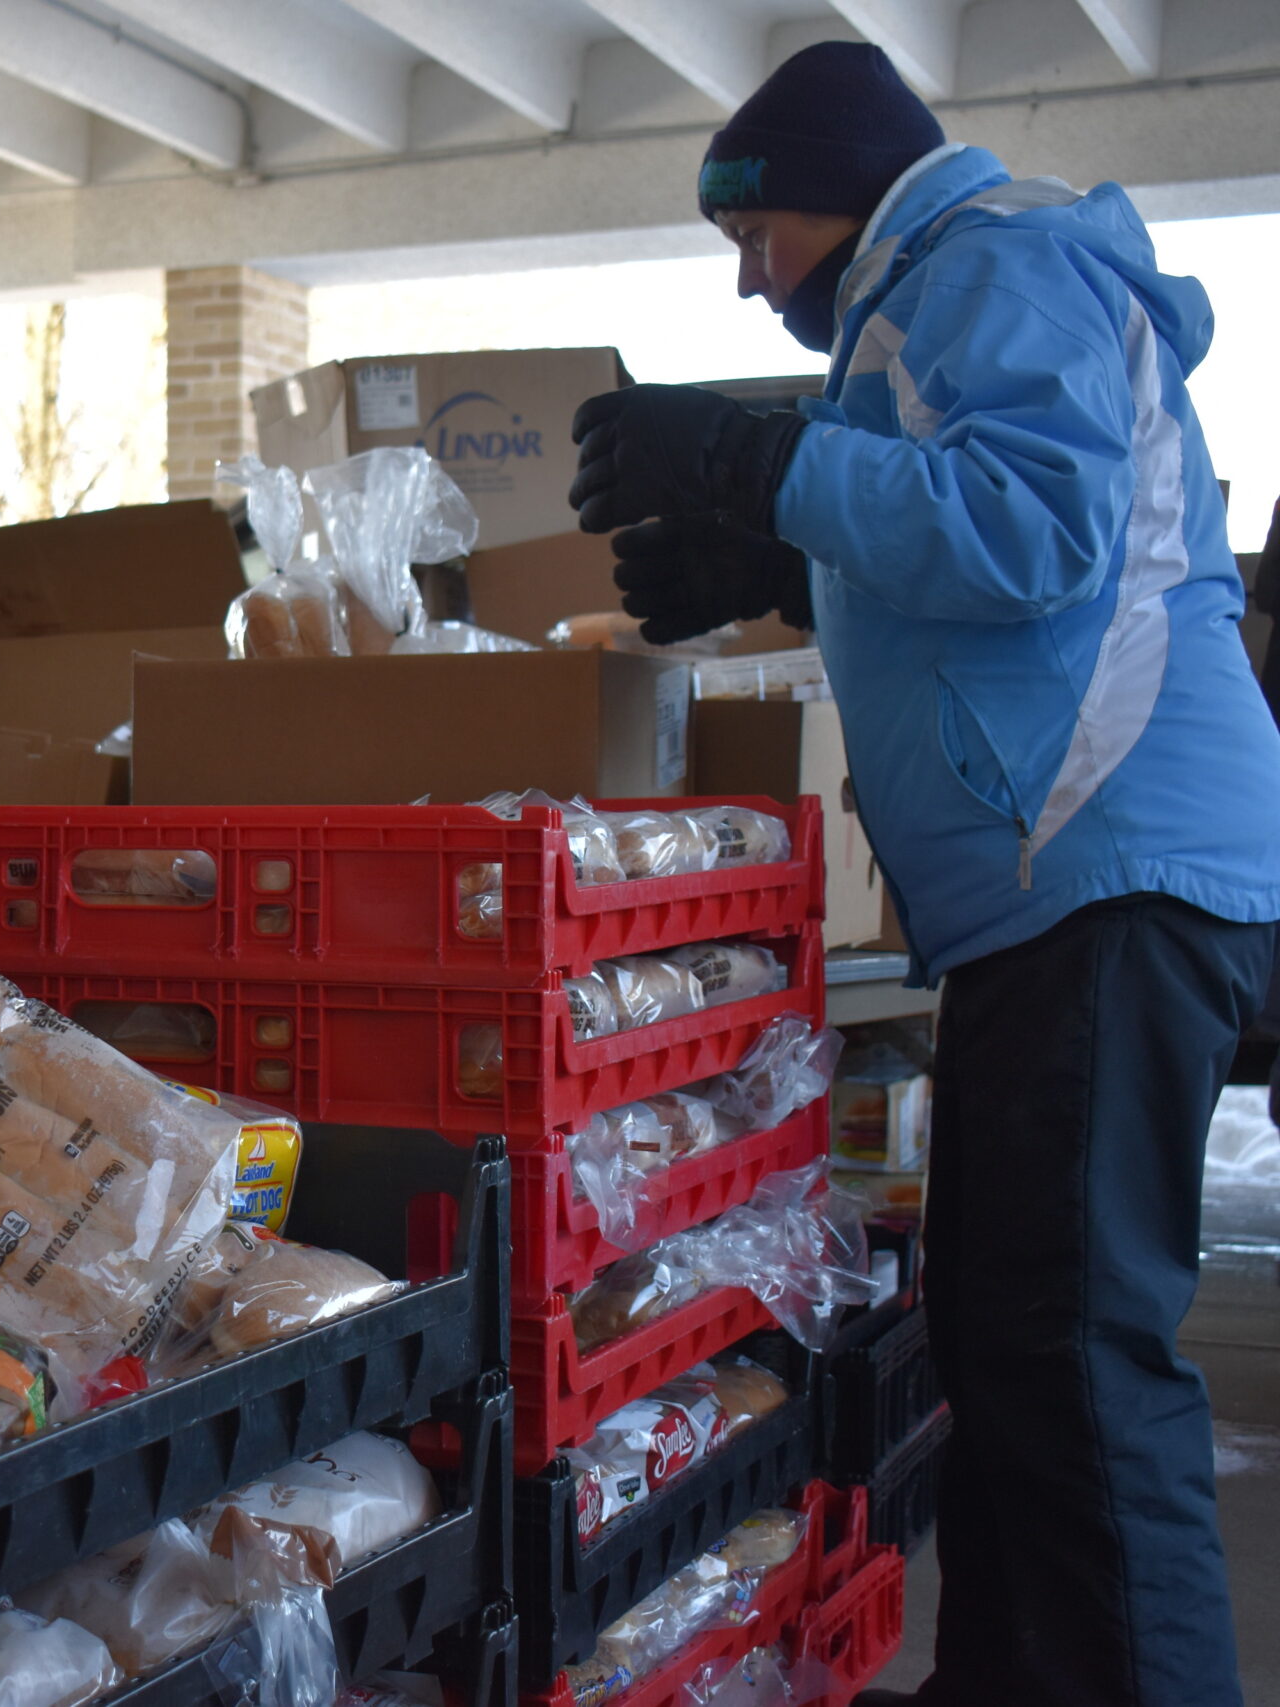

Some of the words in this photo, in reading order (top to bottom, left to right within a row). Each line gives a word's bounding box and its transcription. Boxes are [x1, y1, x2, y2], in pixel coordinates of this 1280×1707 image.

[436, 426, 544, 463] LINDAR
[260, 1185, 284, 1213] DOG
[23, 1261, 47, 1287] NET
[40, 1246, 60, 1266] WT
[54, 1237, 67, 1251] 2
[61, 1218, 80, 1241] LBS
[72, 1201, 94, 1222] 2.4
[86, 1186, 104, 1205] OZ
[121, 1242, 203, 1347] FOODSERVICE
[654, 1432, 680, 1480] Sara
[675, 1417, 695, 1457] Lee
[586, 1490, 601, 1536] Lee
